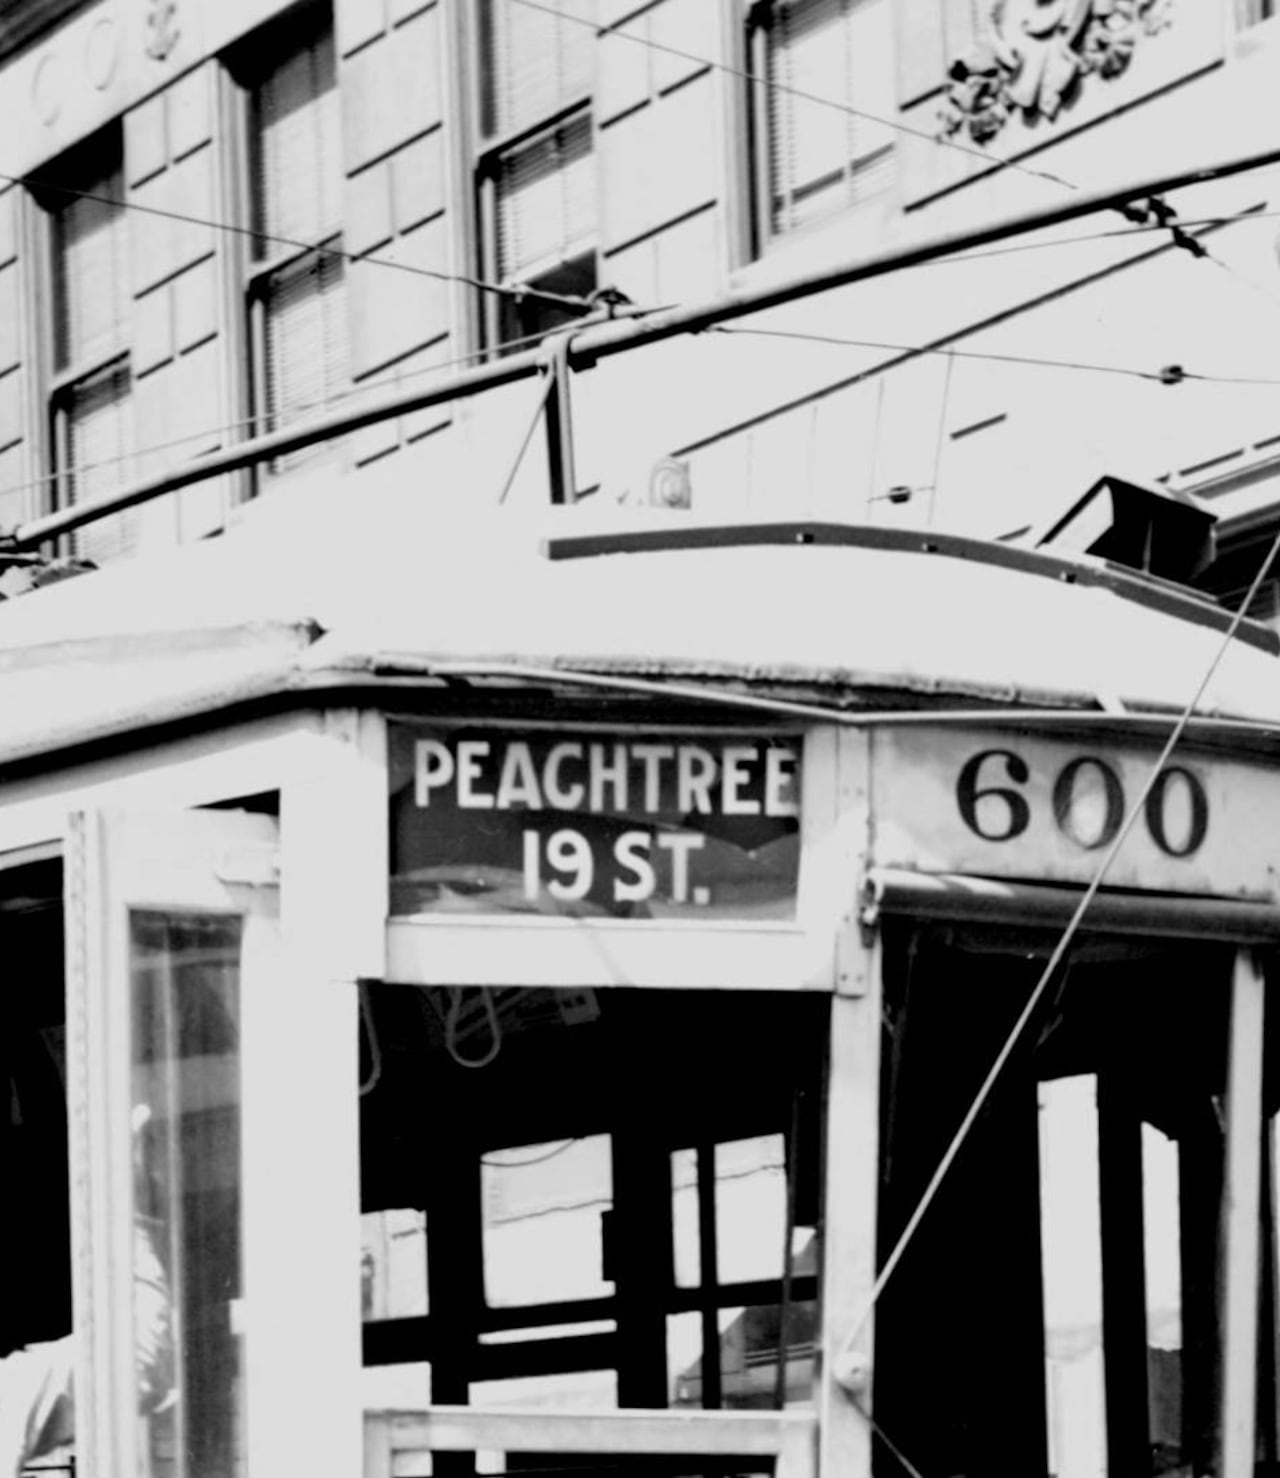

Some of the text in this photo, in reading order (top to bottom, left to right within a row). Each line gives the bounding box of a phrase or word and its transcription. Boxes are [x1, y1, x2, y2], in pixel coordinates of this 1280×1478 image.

[414, 738, 799, 817] PEACHTREE
[955, 747, 1209, 858] 600
[522, 828, 710, 905] 19 ST.
